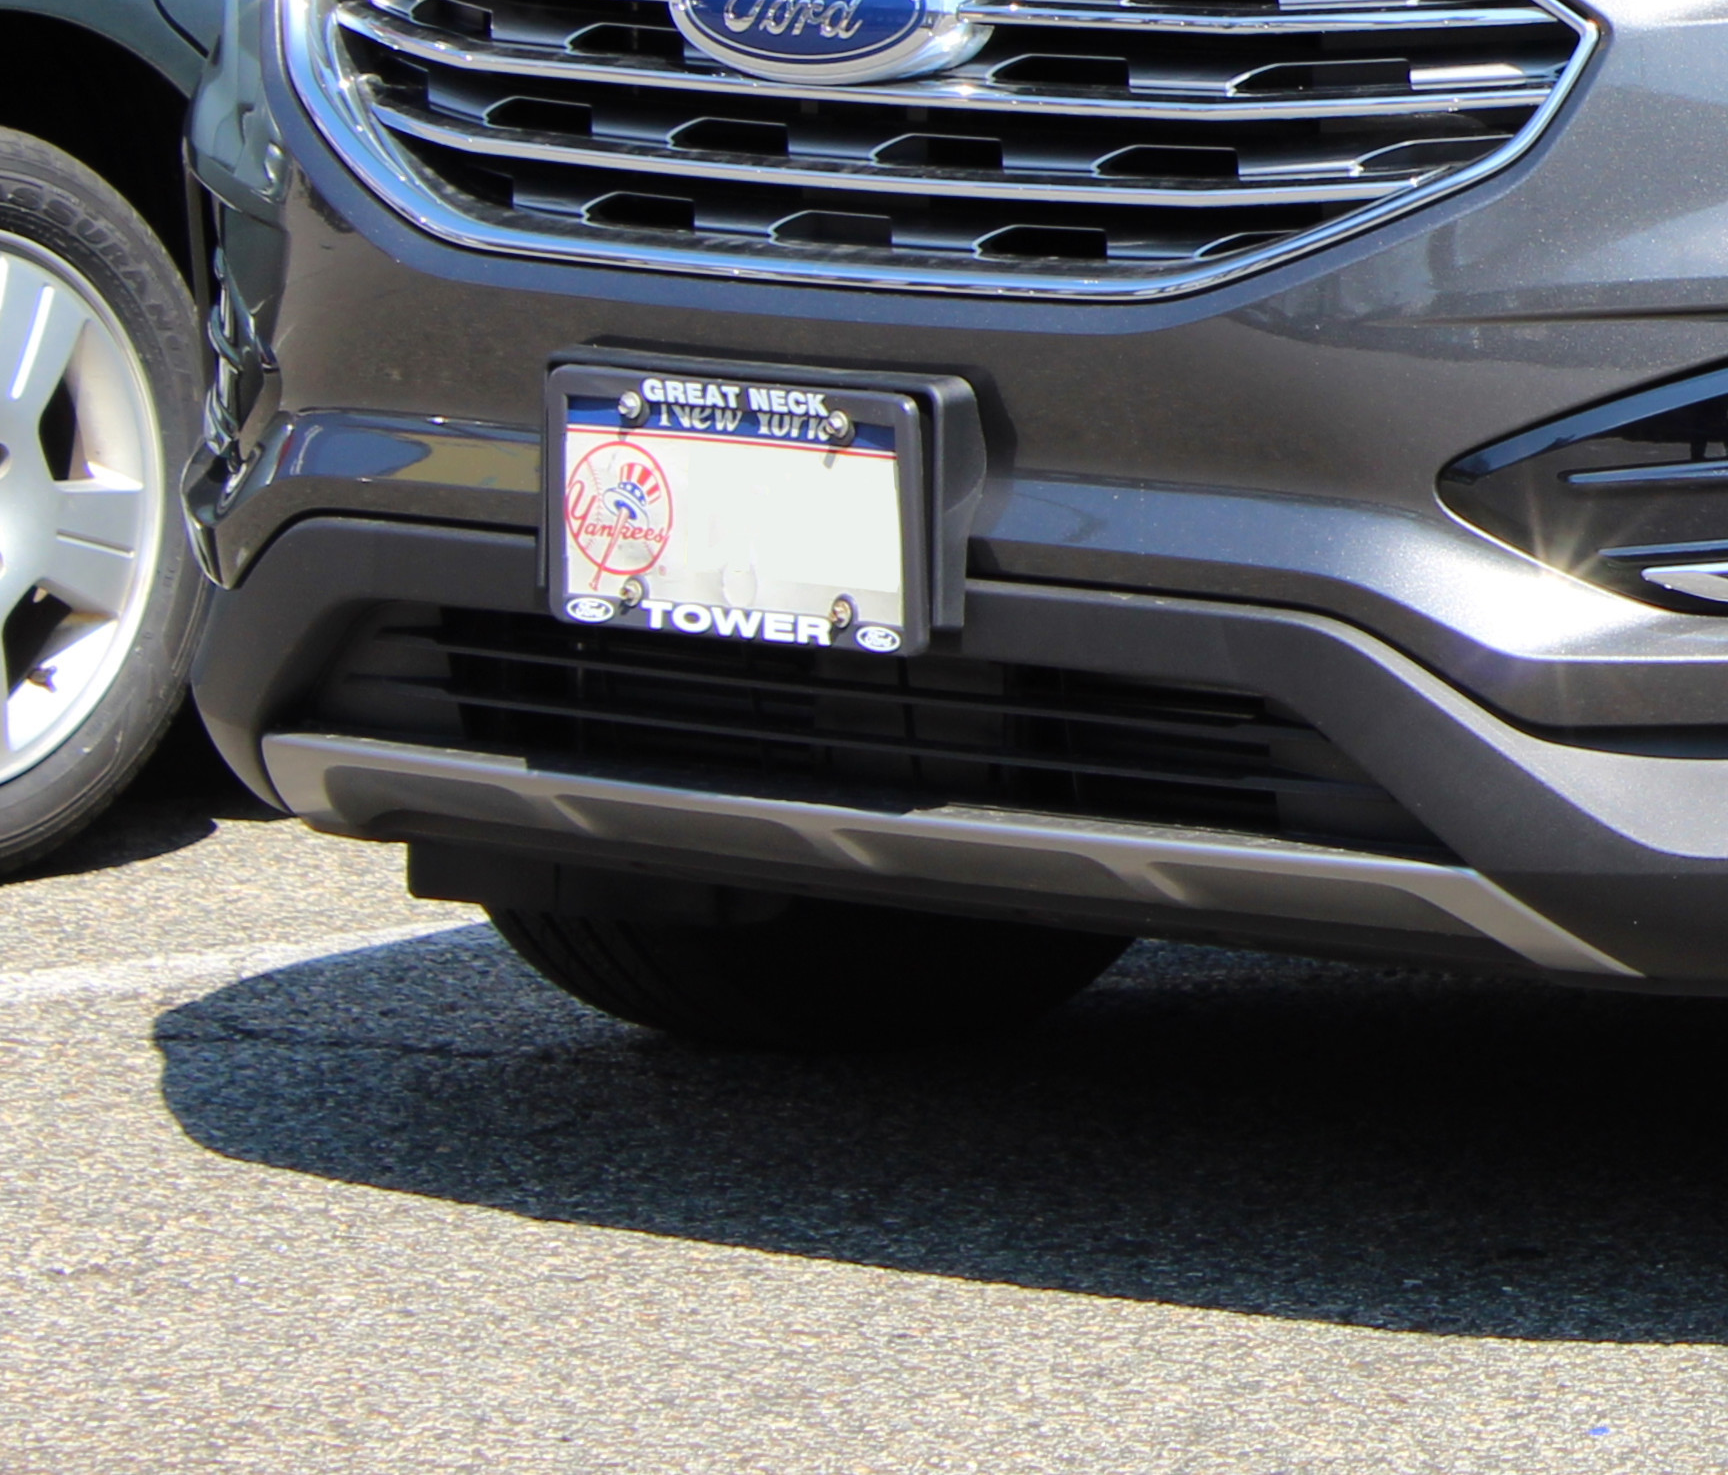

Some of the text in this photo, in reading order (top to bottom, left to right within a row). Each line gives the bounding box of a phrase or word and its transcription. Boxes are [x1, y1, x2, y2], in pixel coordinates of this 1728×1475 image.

[641, 378, 830, 418] GREAT NECK
[658, 402, 834, 442] New York
[567, 479, 669, 544] Yankees
[640, 598, 832, 647] TOWER
